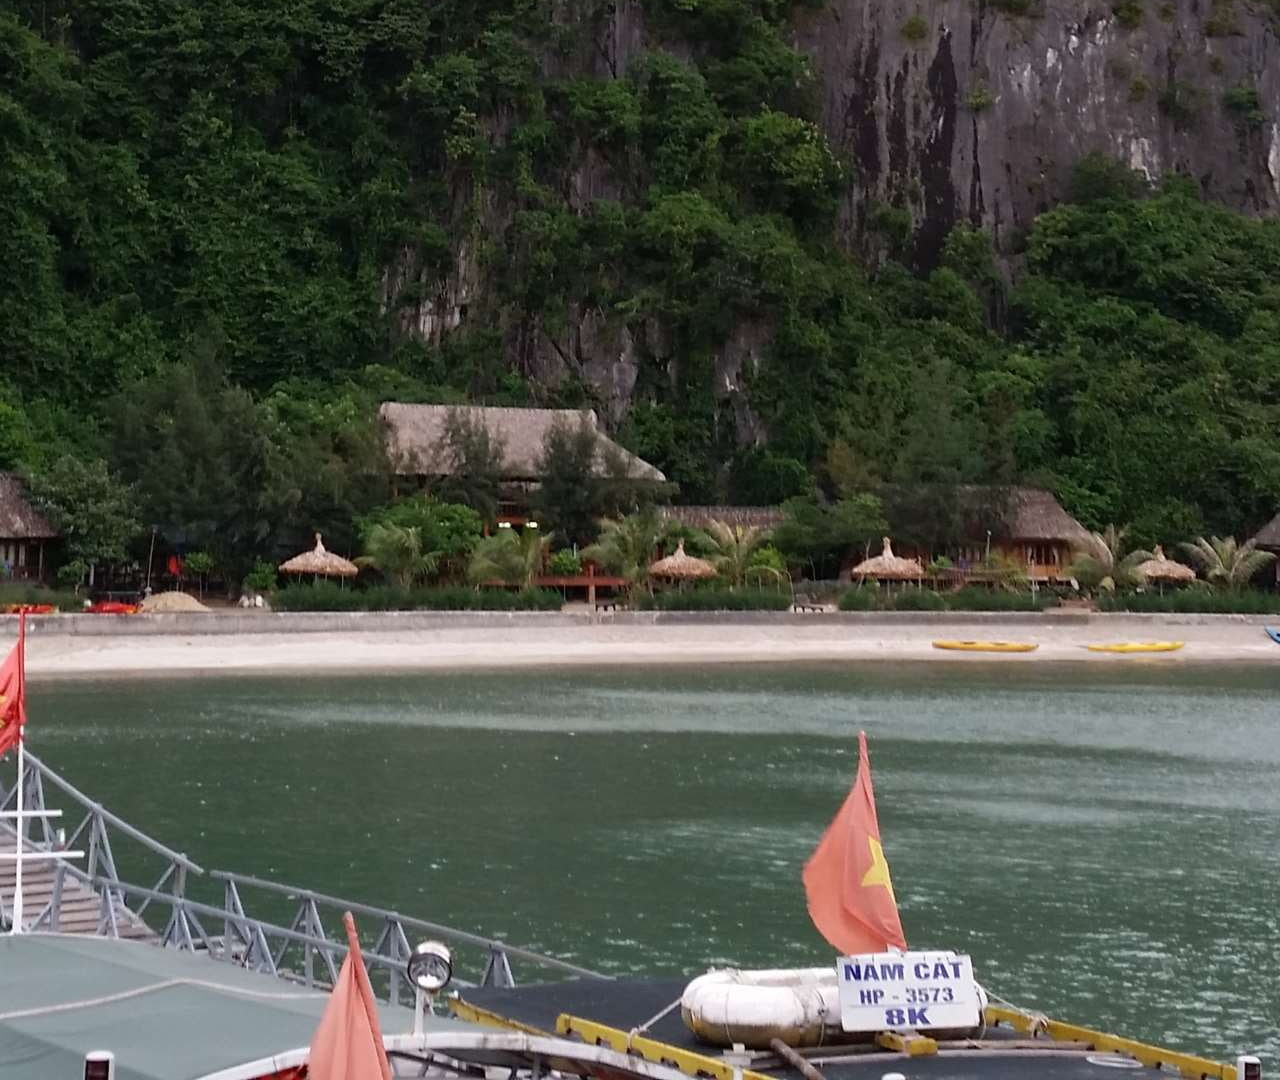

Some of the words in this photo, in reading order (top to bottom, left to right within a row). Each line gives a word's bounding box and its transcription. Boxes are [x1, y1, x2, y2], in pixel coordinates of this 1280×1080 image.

[844, 963, 905, 981] NAM
[860, 989, 884, 1004] HP
[905, 987, 954, 1003] 3573
[885, 1008, 931, 1025] 8K
